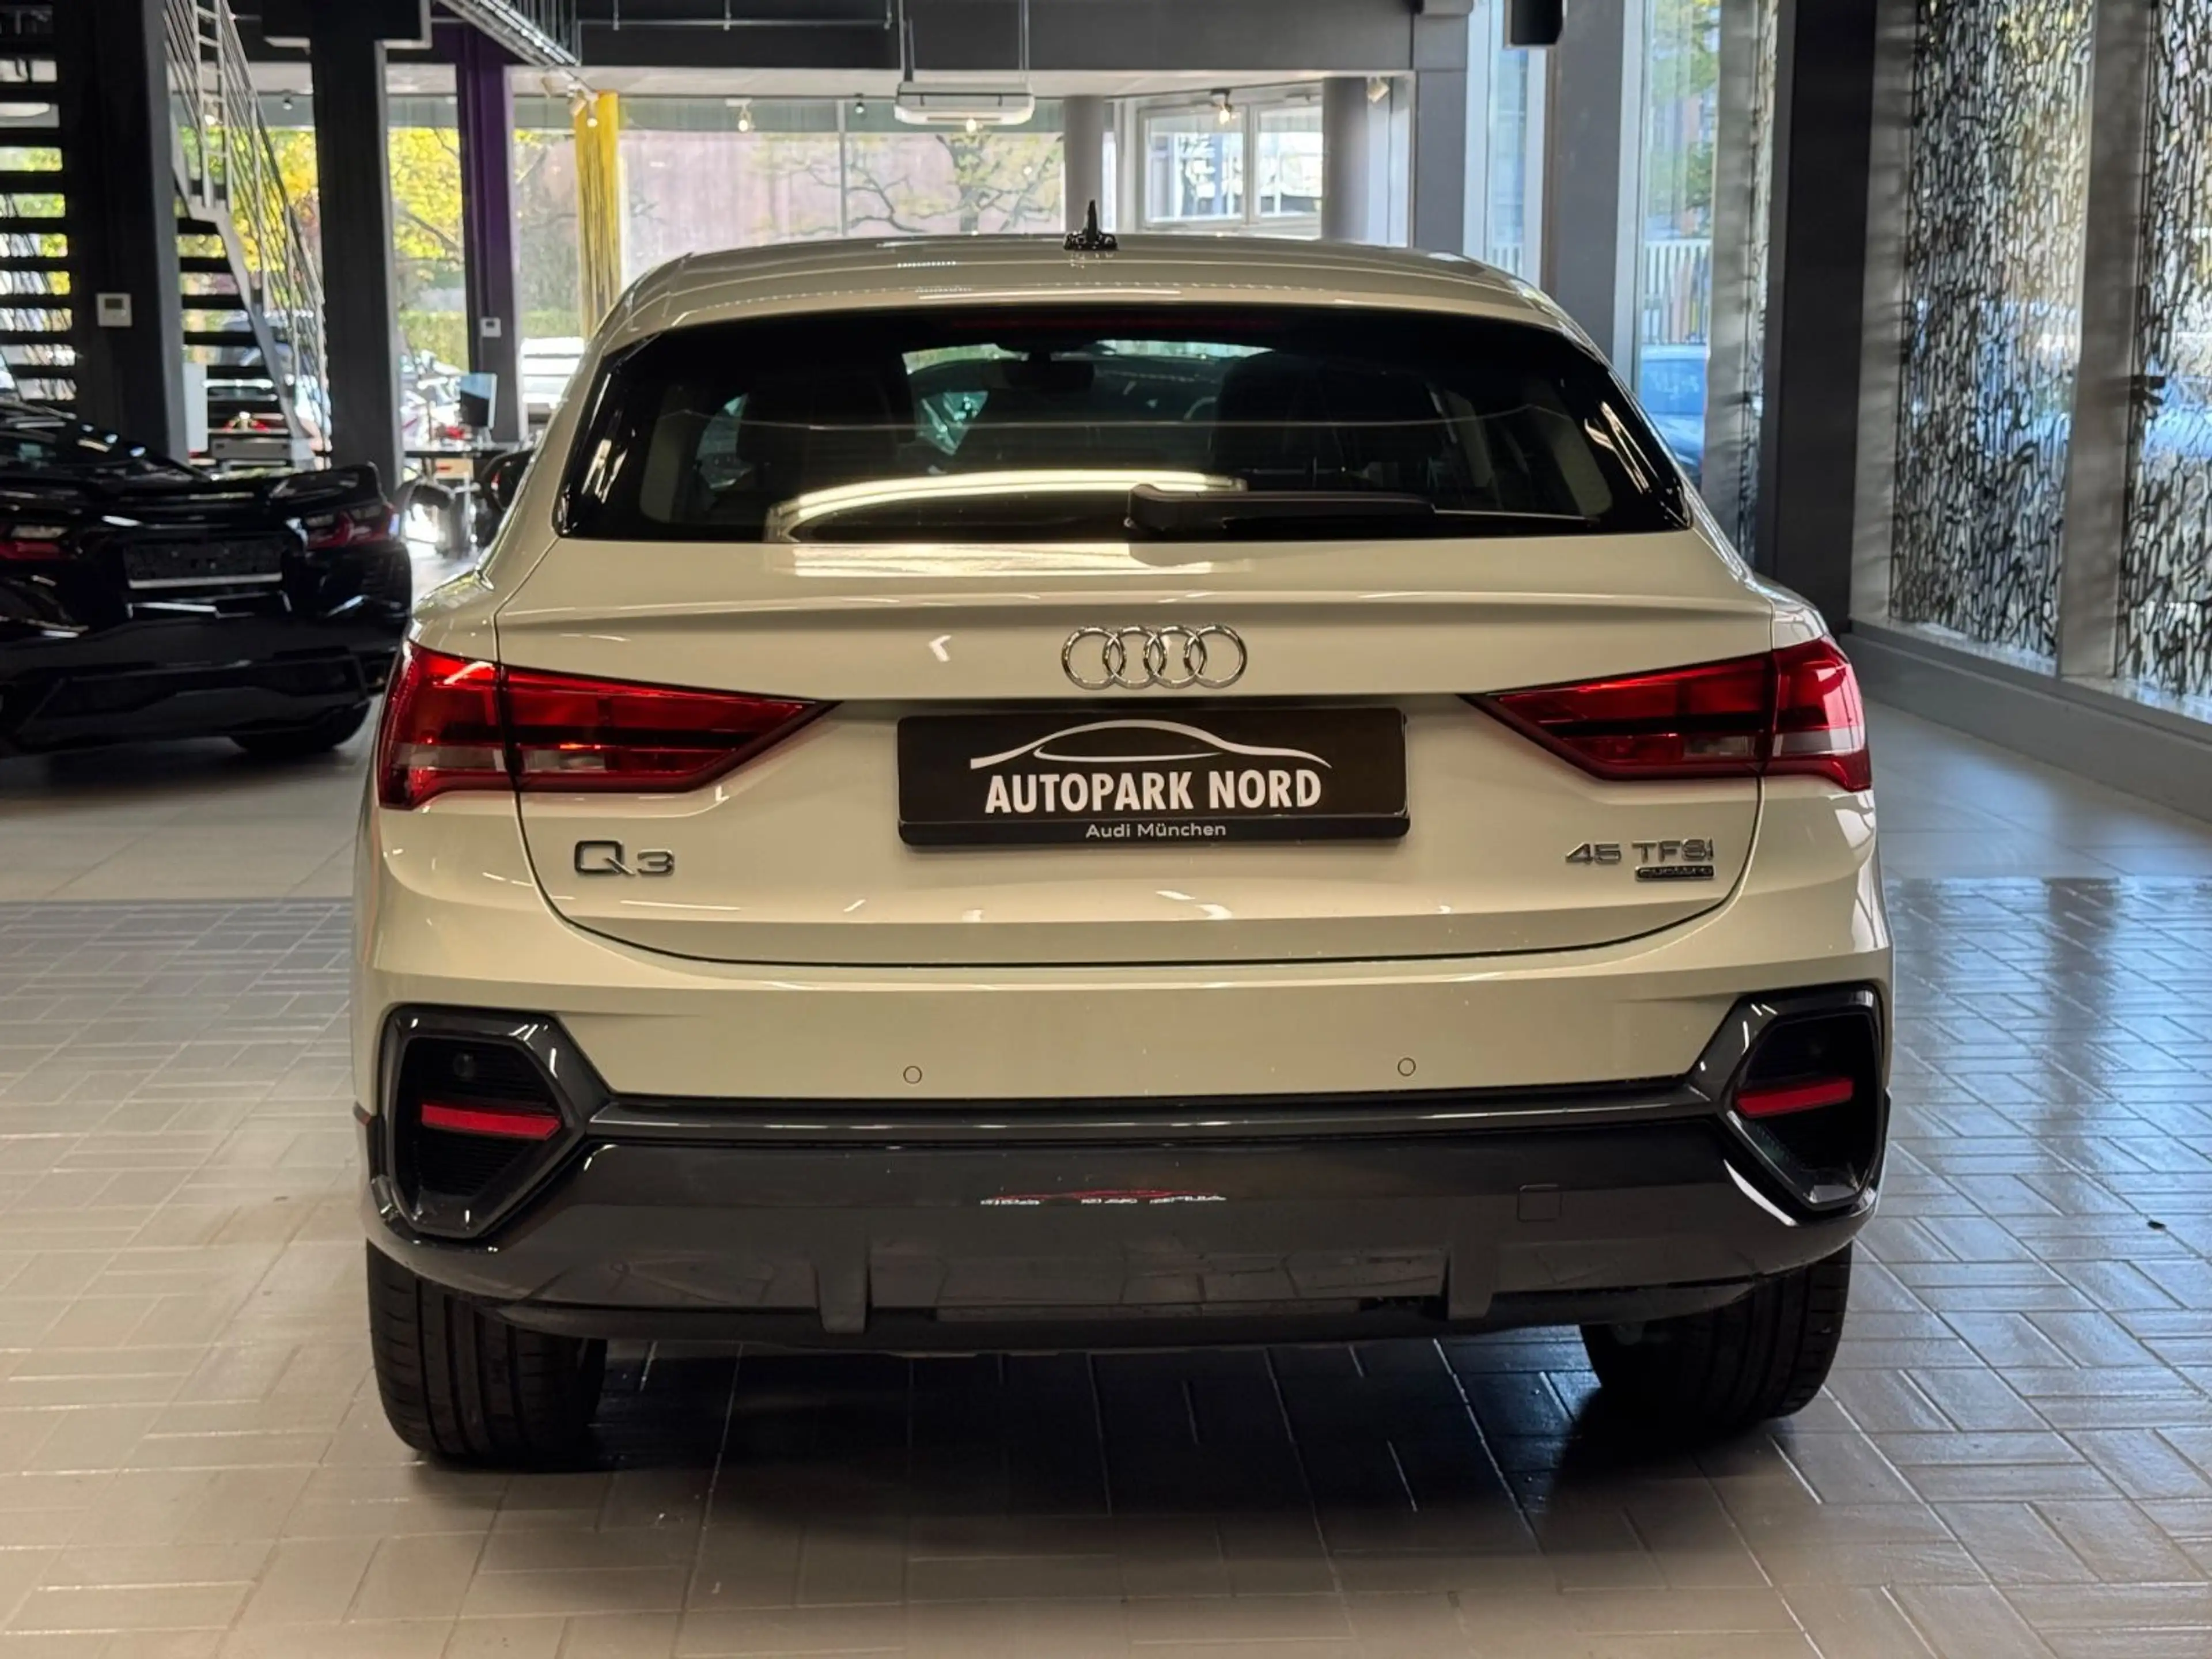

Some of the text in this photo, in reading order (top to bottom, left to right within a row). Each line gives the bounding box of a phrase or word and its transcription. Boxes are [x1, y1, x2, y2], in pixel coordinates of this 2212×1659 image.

[984, 769, 1321, 813] AUTOPARK NORD
[1085, 823, 1226, 838] Audi München
[574, 840, 675, 876] Q3
[1565, 842, 1622, 864] 45
